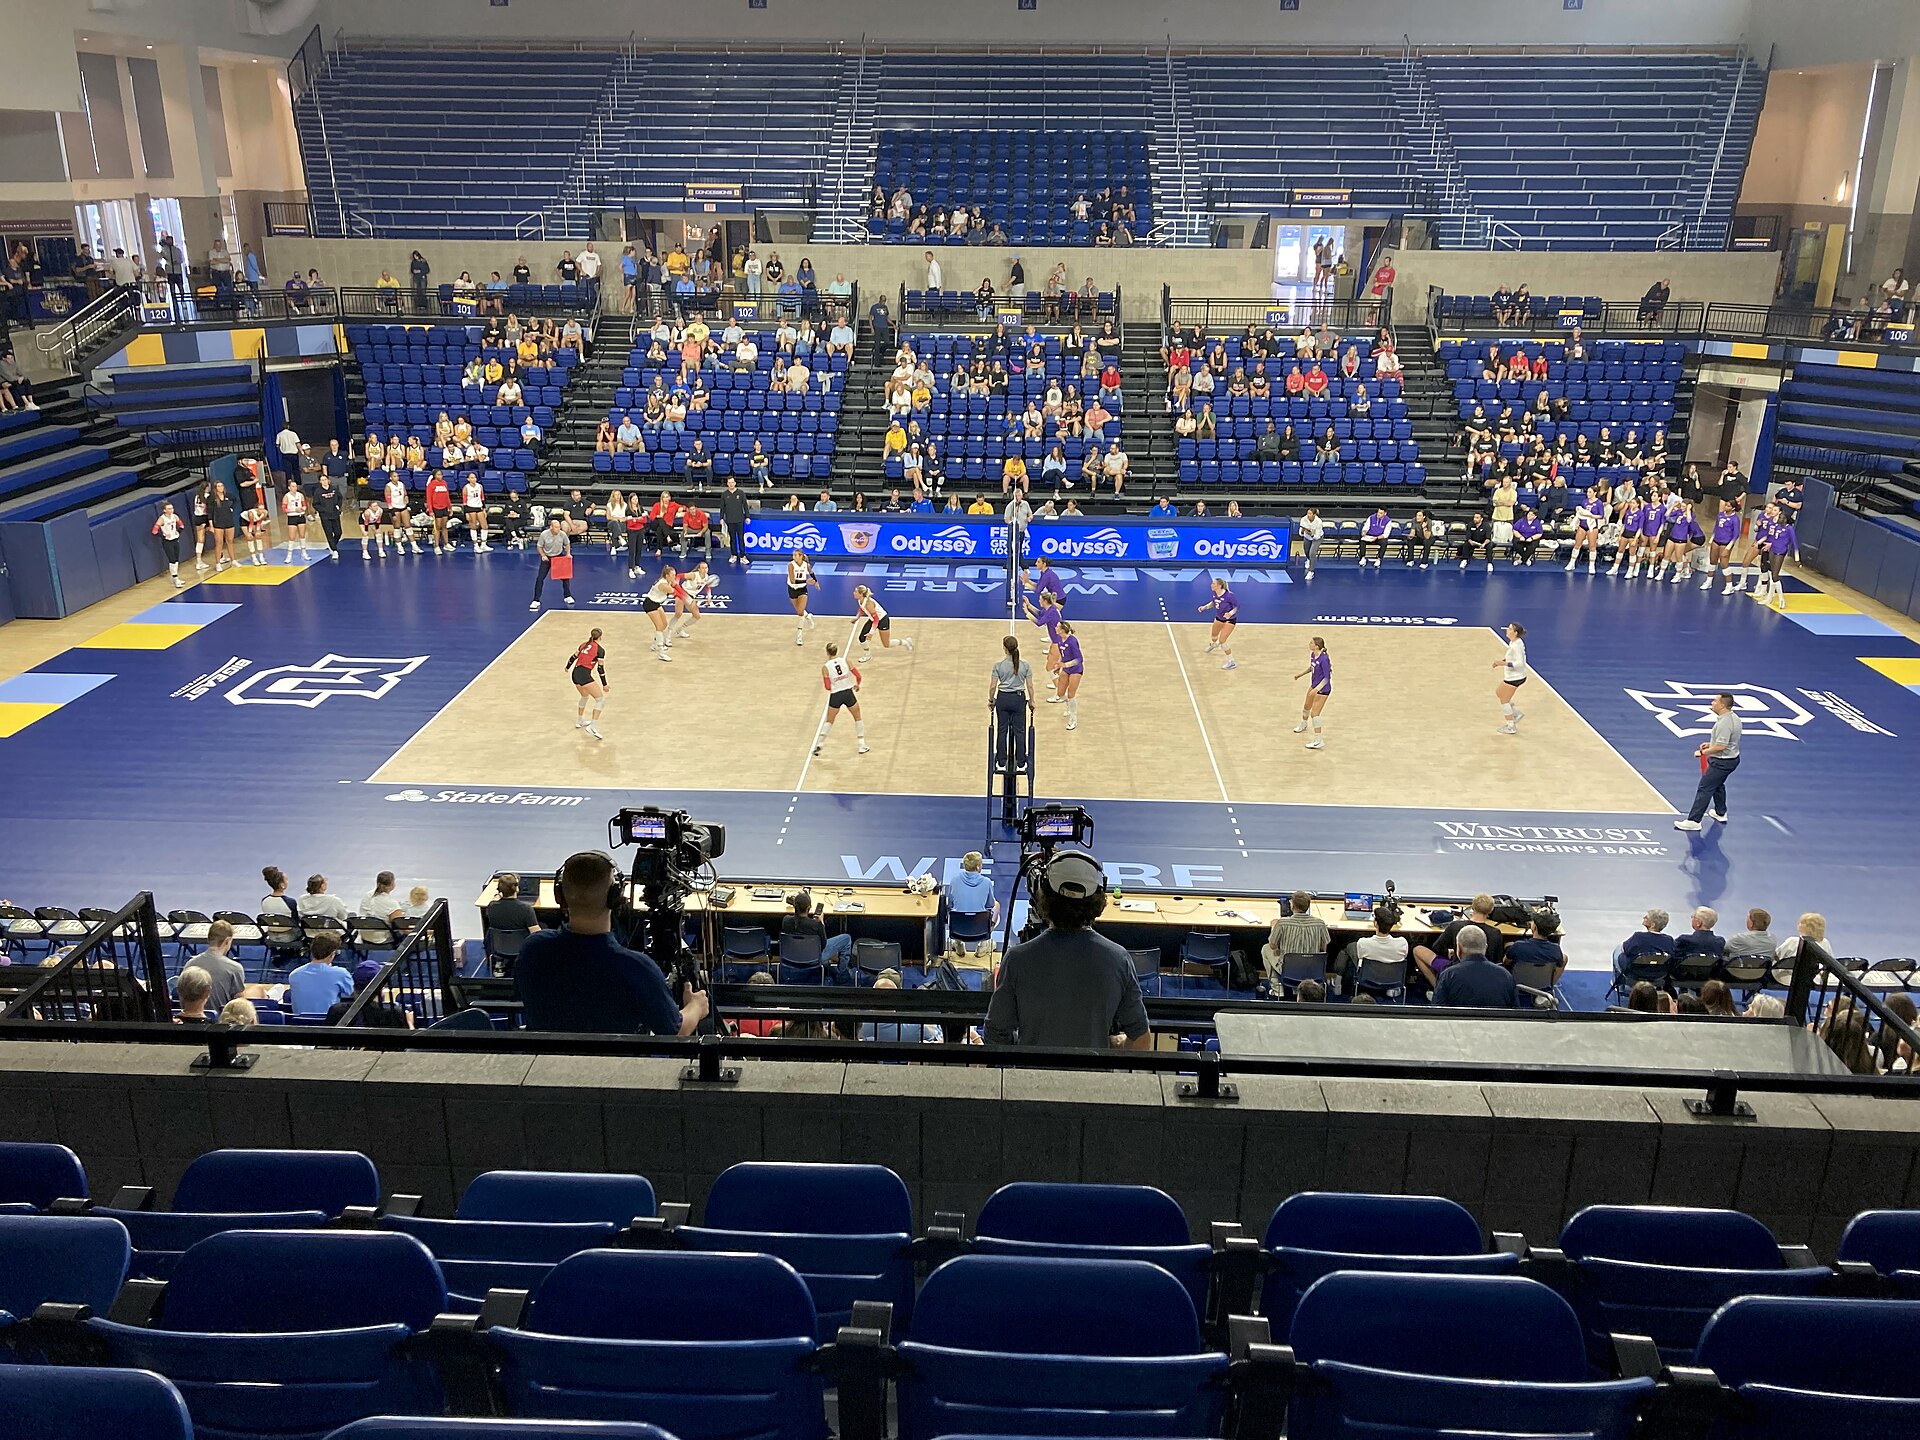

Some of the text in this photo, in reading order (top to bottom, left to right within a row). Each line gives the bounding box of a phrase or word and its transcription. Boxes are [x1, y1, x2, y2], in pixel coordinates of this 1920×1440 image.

[150, 309, 167, 319] 120
[457, 304, 472, 315] 101
[738, 307, 755, 317] 102
[1002, 315, 1017, 325] 103
[1270, 312, 1286, 322] 104
[1562, 316, 1578, 326] 105
[1889, 330, 1908, 341] 106
[990, 527, 1031, 537] FEA
[744, 532, 827, 552] Odyssey
[891, 535, 977, 555] Odyssey
[990, 540, 1031, 548] GRK
[1041, 538, 1129, 557] Odyssey
[1194, 539, 1283, 559] Odyssey
[884, 580, 1003, 593] ARE
[834, 664, 843, 676] 8
[1433, 821, 1652, 841] WINTRUST
[1453, 842, 1666, 856] WISCONSIN'S BANK
